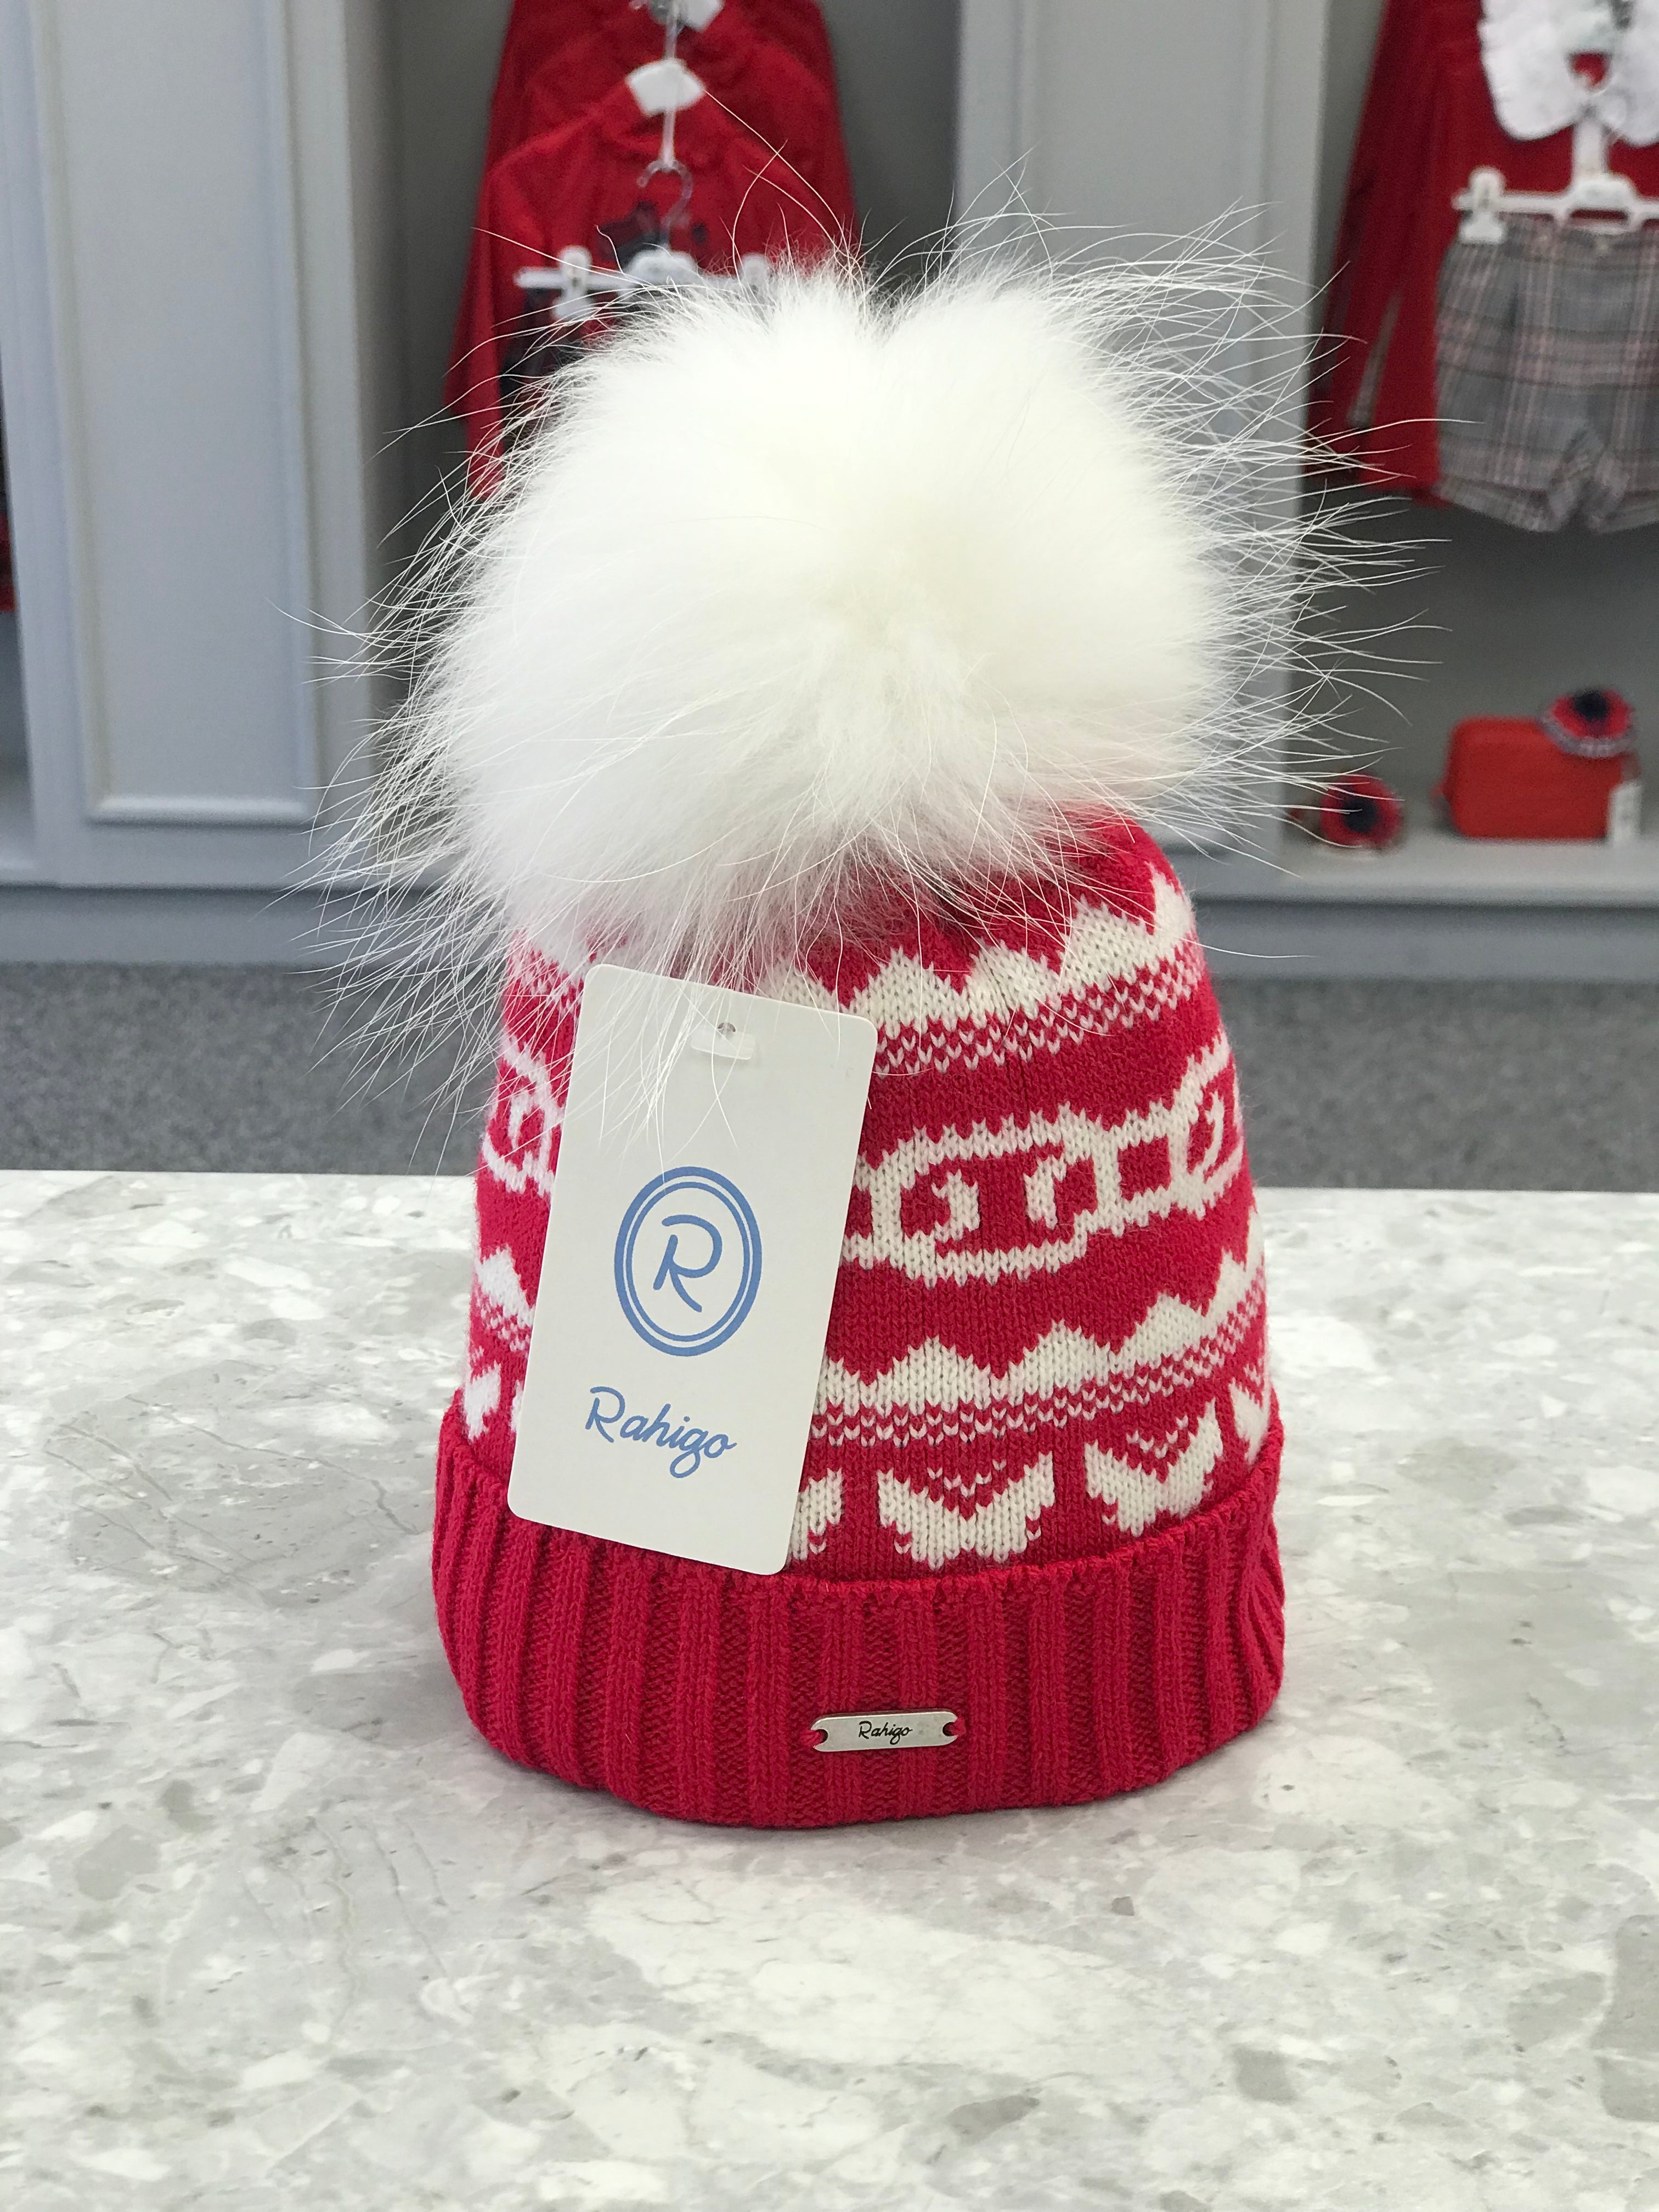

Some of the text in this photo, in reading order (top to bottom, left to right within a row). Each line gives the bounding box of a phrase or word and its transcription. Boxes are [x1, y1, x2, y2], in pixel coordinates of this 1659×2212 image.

[653, 1214, 723, 1313] R
[585, 1386, 737, 1479] Rahigo
[858, 1720, 913, 1745] Rahigo
